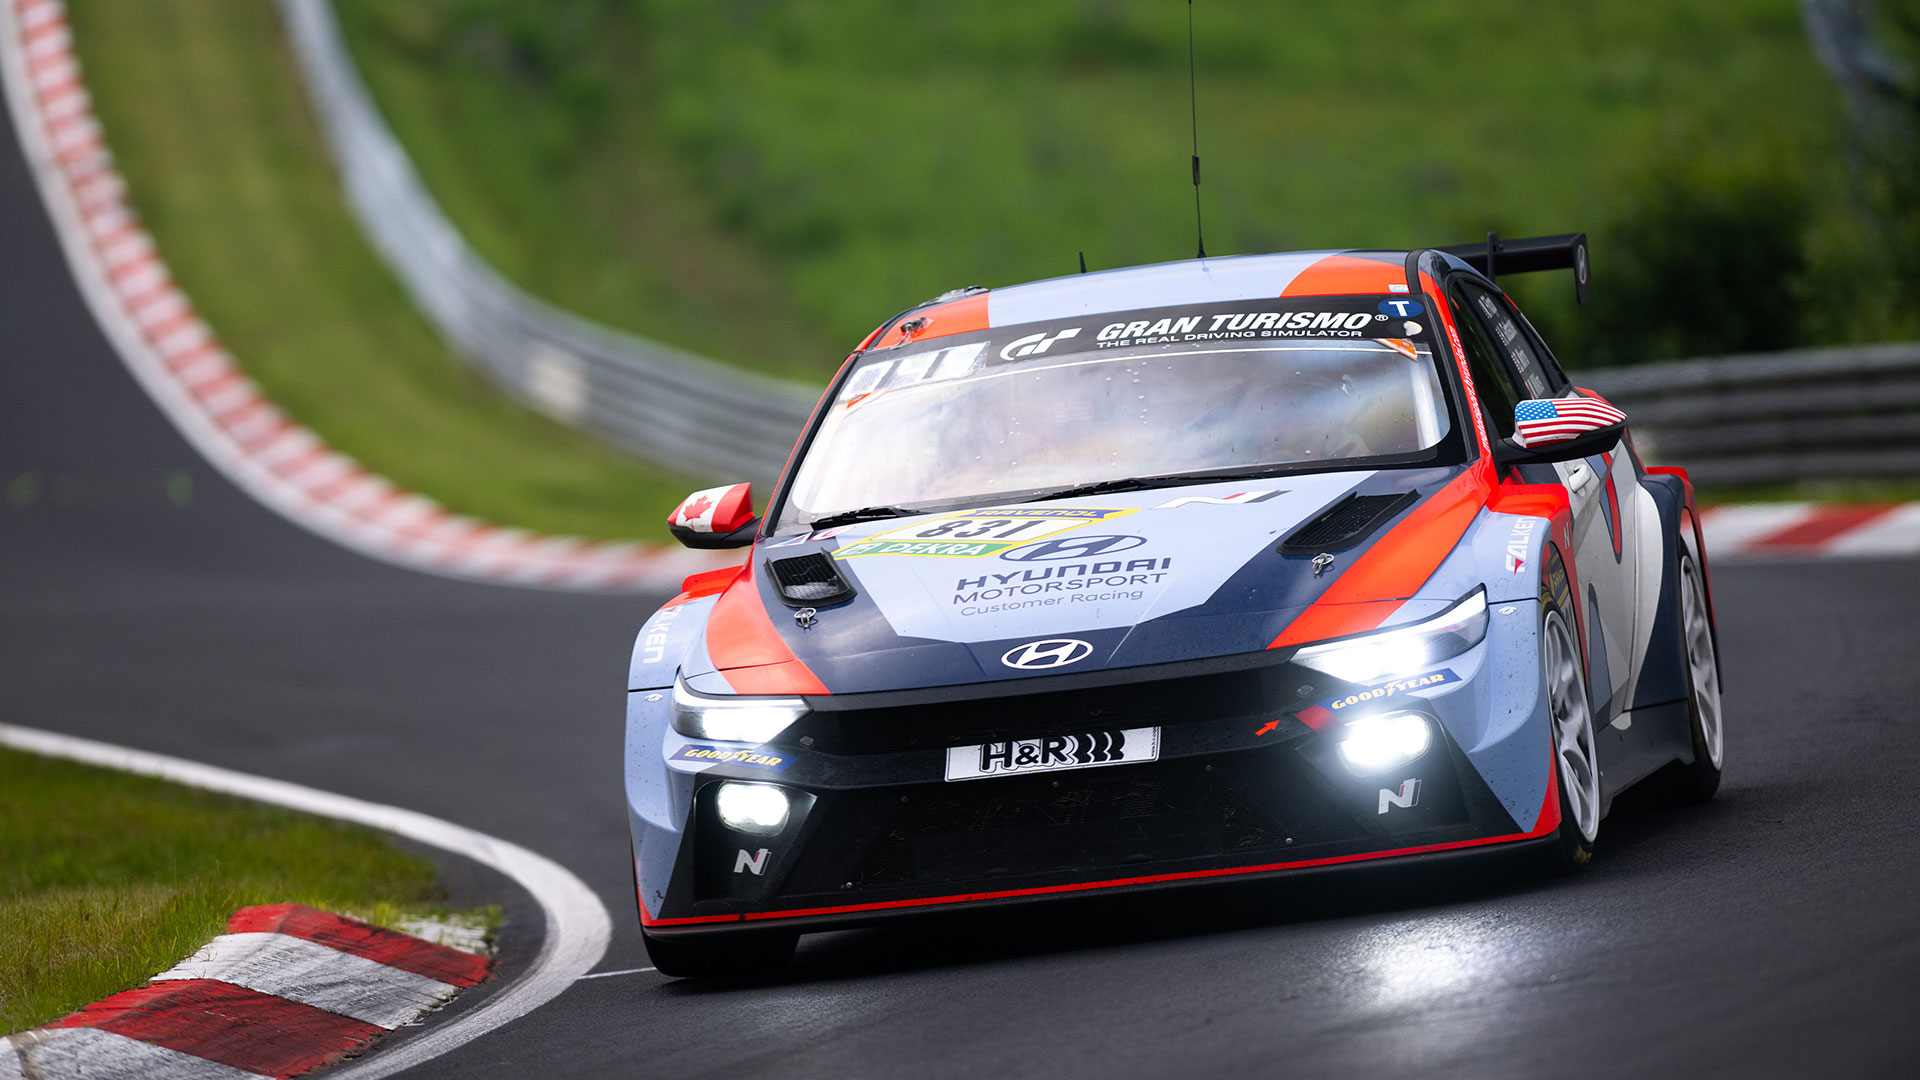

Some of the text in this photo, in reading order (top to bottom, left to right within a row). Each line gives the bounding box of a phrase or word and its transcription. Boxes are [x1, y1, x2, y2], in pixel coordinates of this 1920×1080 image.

[1388, 300, 1410, 317] T
[1096, 315, 1203, 341] GRAN
[1096, 329, 1363, 349] THE REAL DRIVING SIMULATOR
[975, 509, 1100, 517] RAVENOL
[915, 519, 1047, 539] 831
[879, 542, 988, 556] DEKRA
[956, 557, 1172, 591] HYUNDAI
[952, 572, 1168, 605] MOTORSPORT
[960, 589, 1144, 617] Customer Racing
[1331, 673, 1446, 710] GOODYEAR
[684, 748, 783, 767] GOODYEAR
